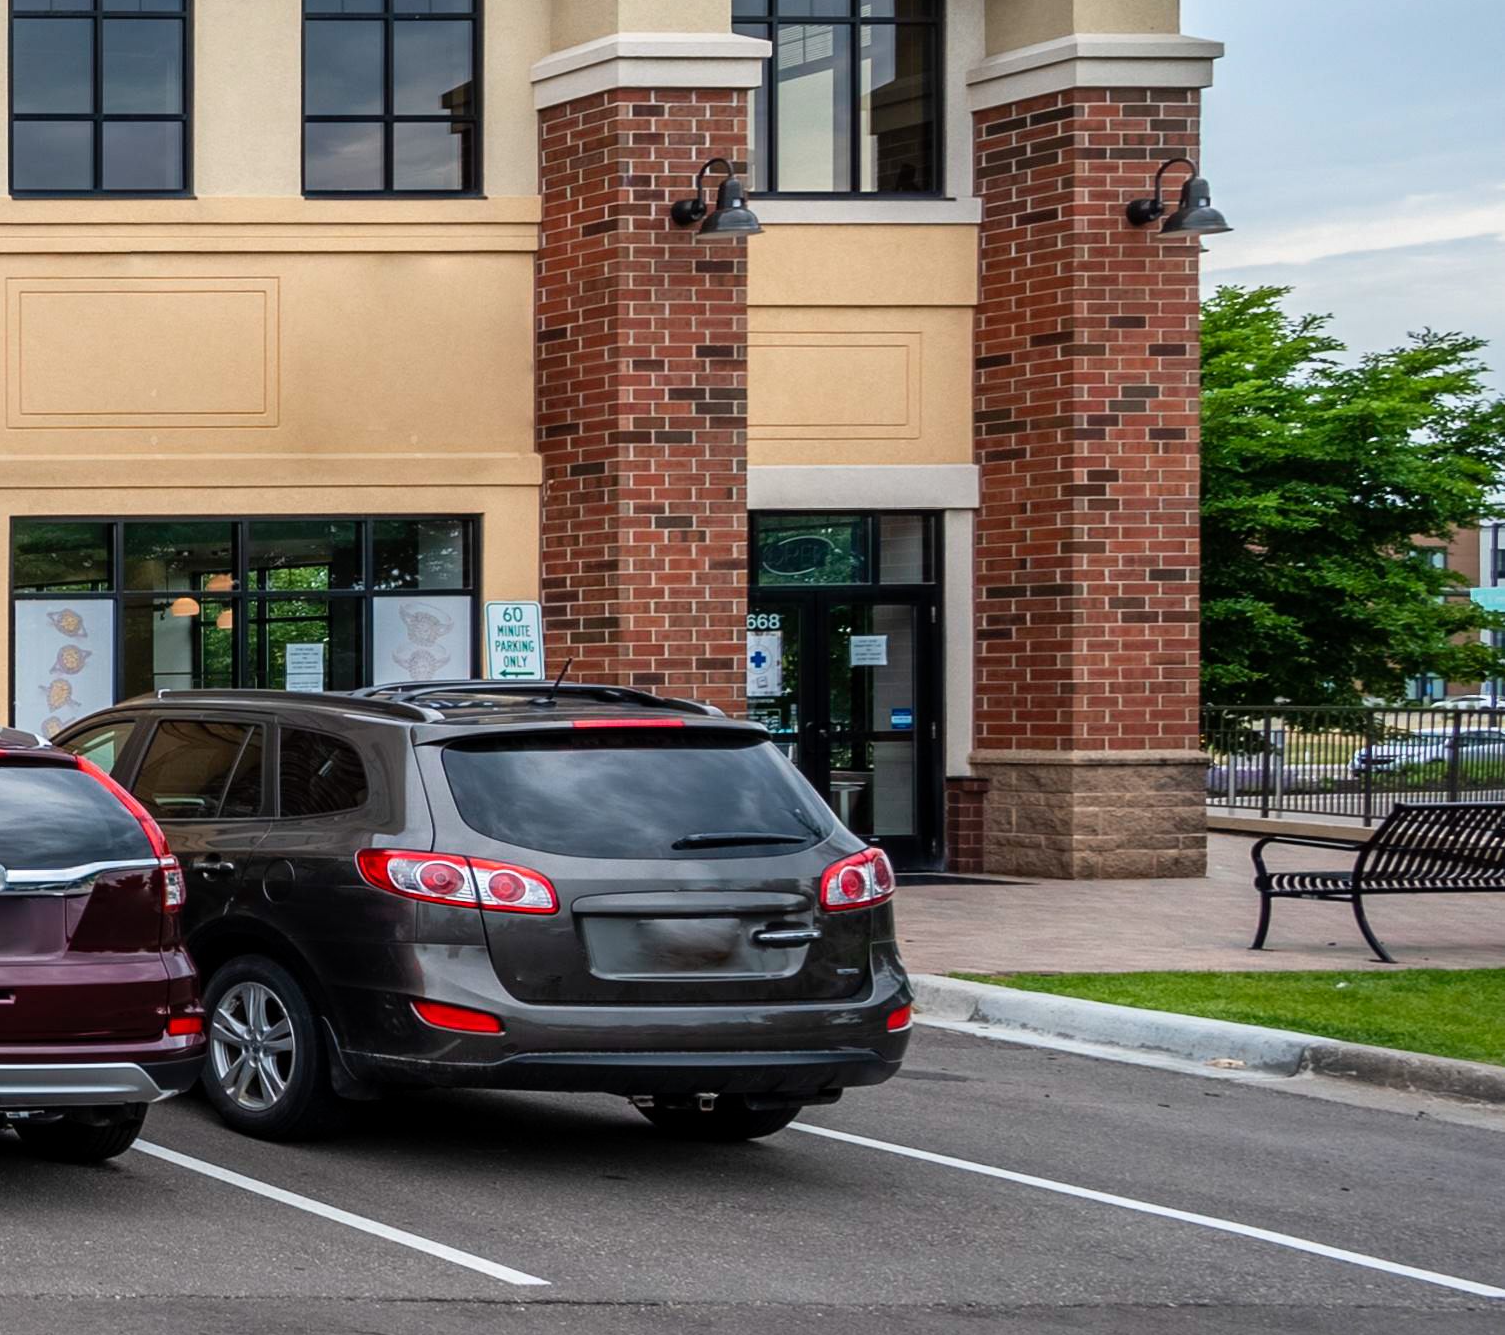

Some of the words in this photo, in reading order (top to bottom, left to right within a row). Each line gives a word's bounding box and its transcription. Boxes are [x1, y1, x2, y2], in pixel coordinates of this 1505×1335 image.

[503, 607, 523, 622] 60
[497, 625, 531, 637] MINUTE
[495, 640, 535, 652] PARKING
[503, 655, 527, 668] ONLY
